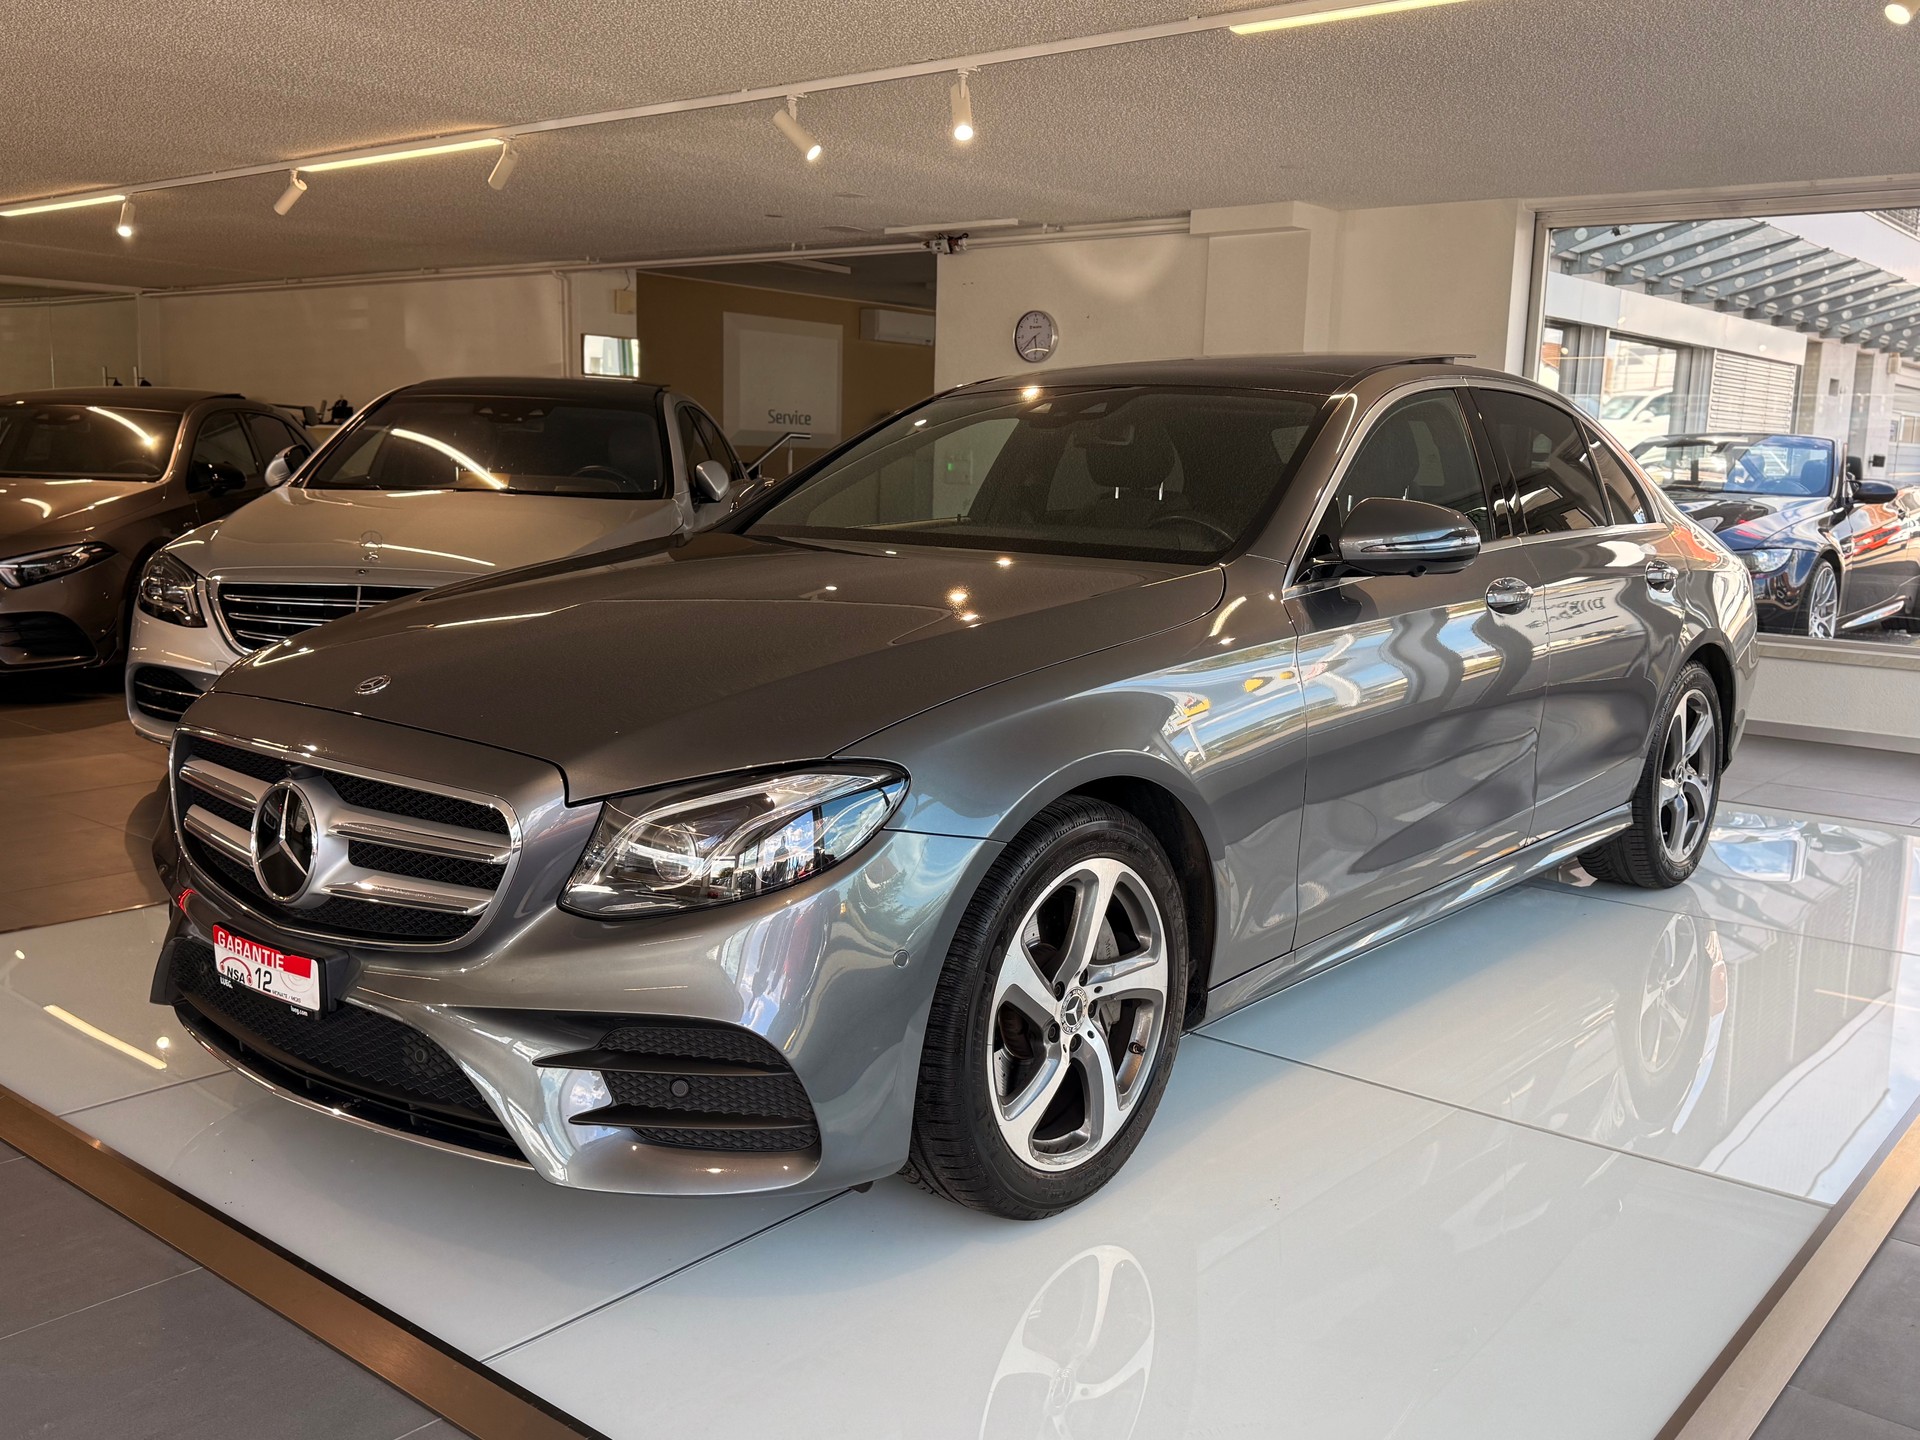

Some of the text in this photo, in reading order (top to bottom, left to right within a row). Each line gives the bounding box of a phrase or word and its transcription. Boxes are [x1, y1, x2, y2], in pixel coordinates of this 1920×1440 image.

[768, 408, 811, 425] Service
[217, 931, 285, 970] GARANTIE
[226, 965, 246, 984] NSA
[255, 967, 272, 993] 12
